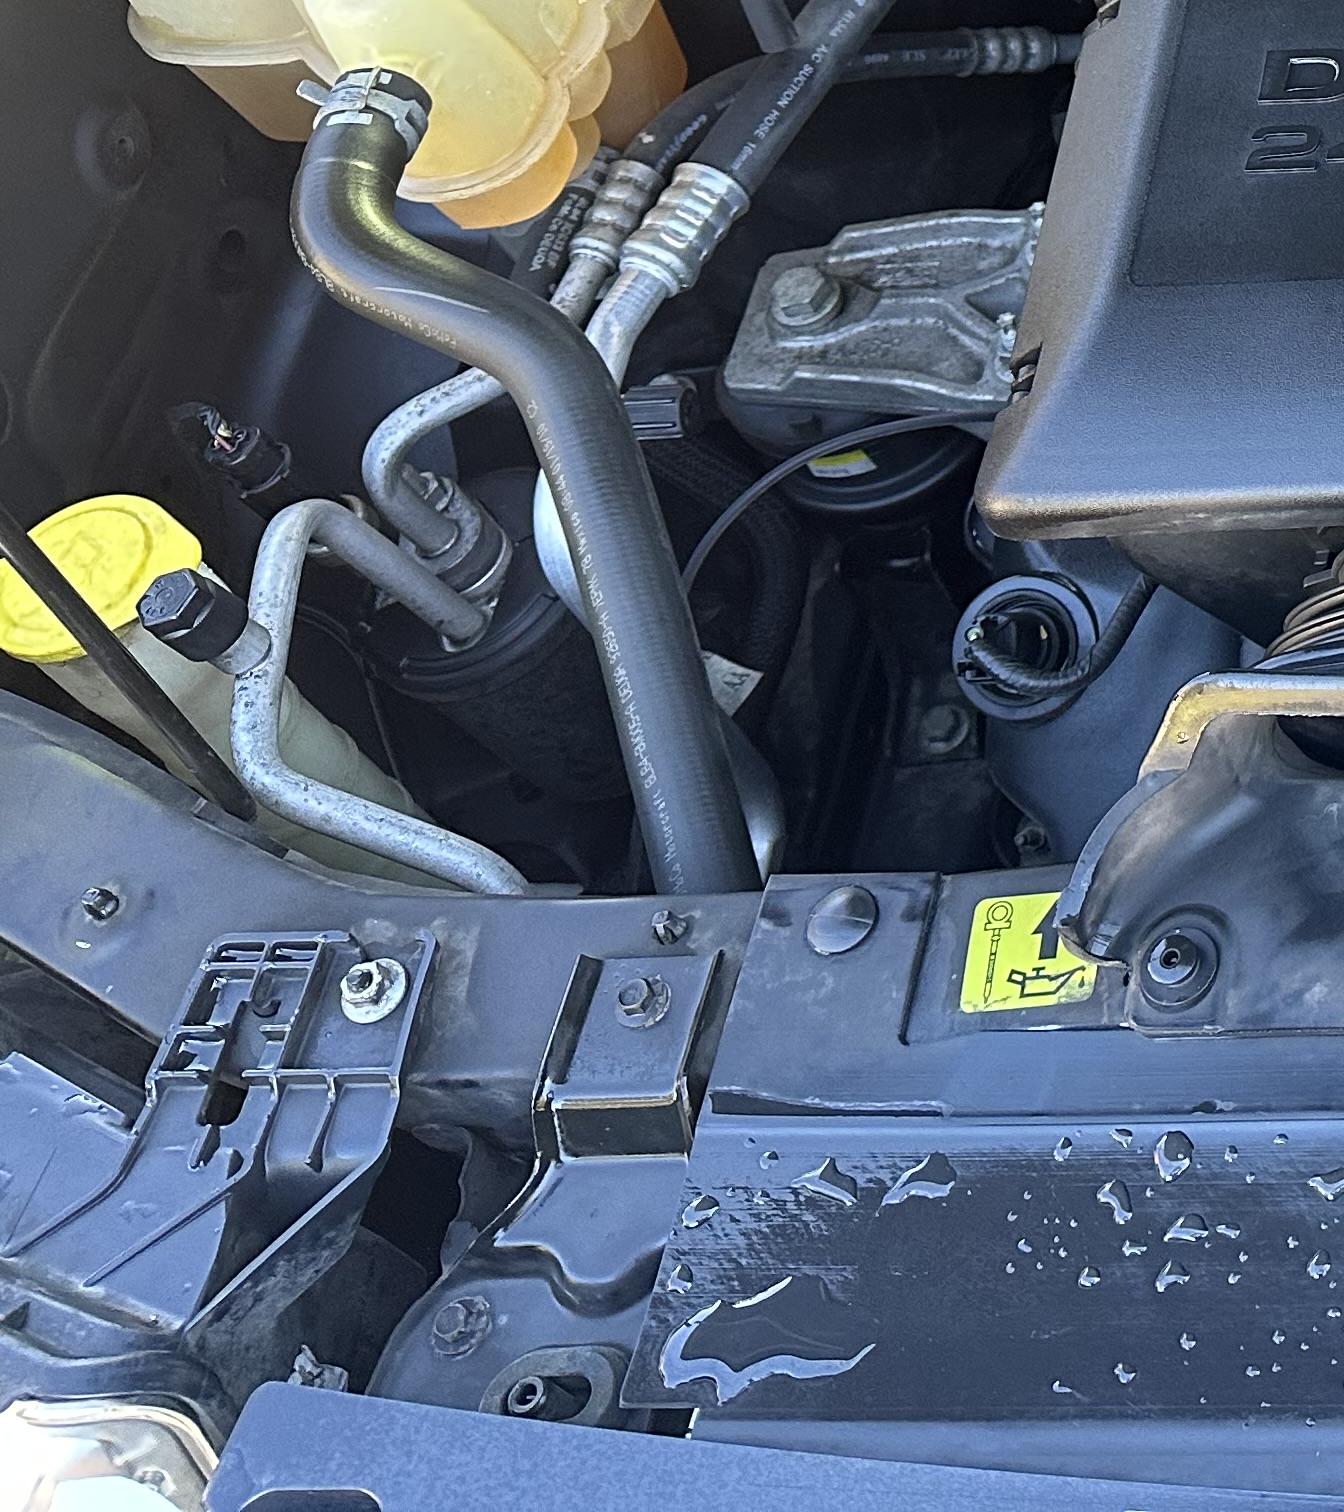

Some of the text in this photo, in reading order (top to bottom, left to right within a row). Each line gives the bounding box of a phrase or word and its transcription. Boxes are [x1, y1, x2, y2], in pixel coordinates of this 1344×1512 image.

[809, 42, 833, 66] A/C
[775, 61, 818, 110] SUCTION
[752, 107, 783, 142] HOSE
[728, 138, 759, 174] 16mm
